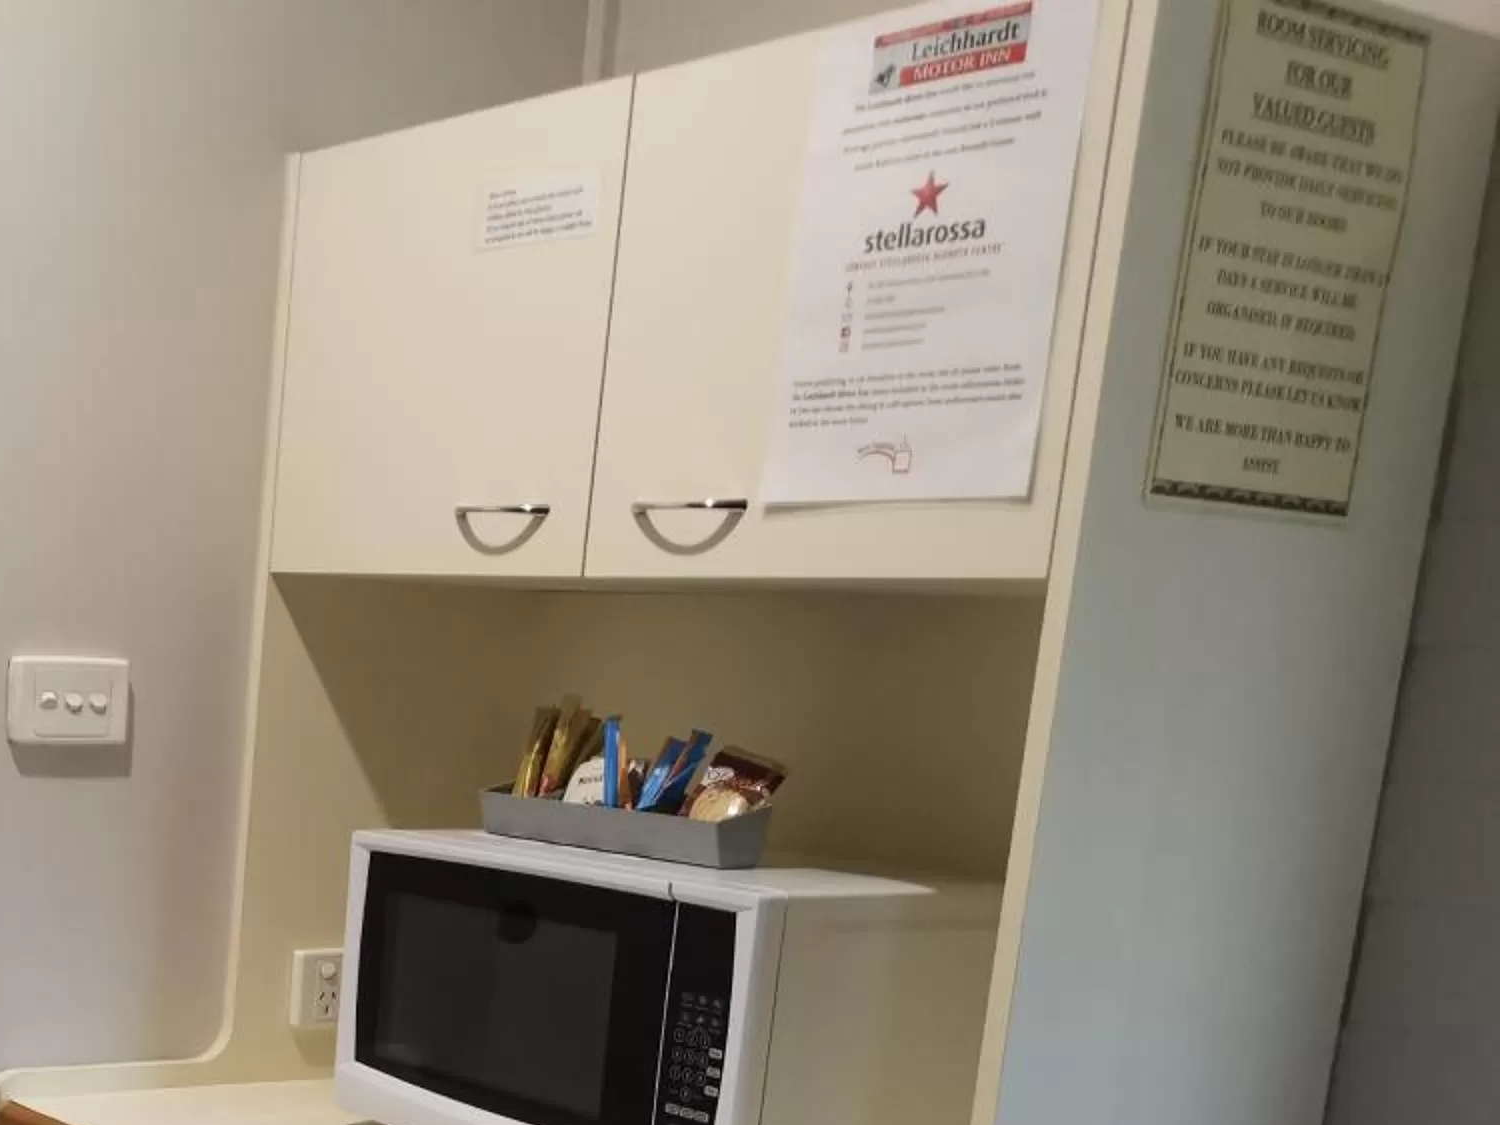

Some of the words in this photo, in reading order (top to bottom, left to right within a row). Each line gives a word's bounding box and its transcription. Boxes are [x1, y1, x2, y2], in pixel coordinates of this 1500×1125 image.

[911, 20, 1020, 61] Leichhardt
[1256, 11, 1305, 42] ROOM
[914, 53, 976, 81] MOTOR
[980, 48, 1012, 67] INN
[865, 218, 986, 253] stellarossa
